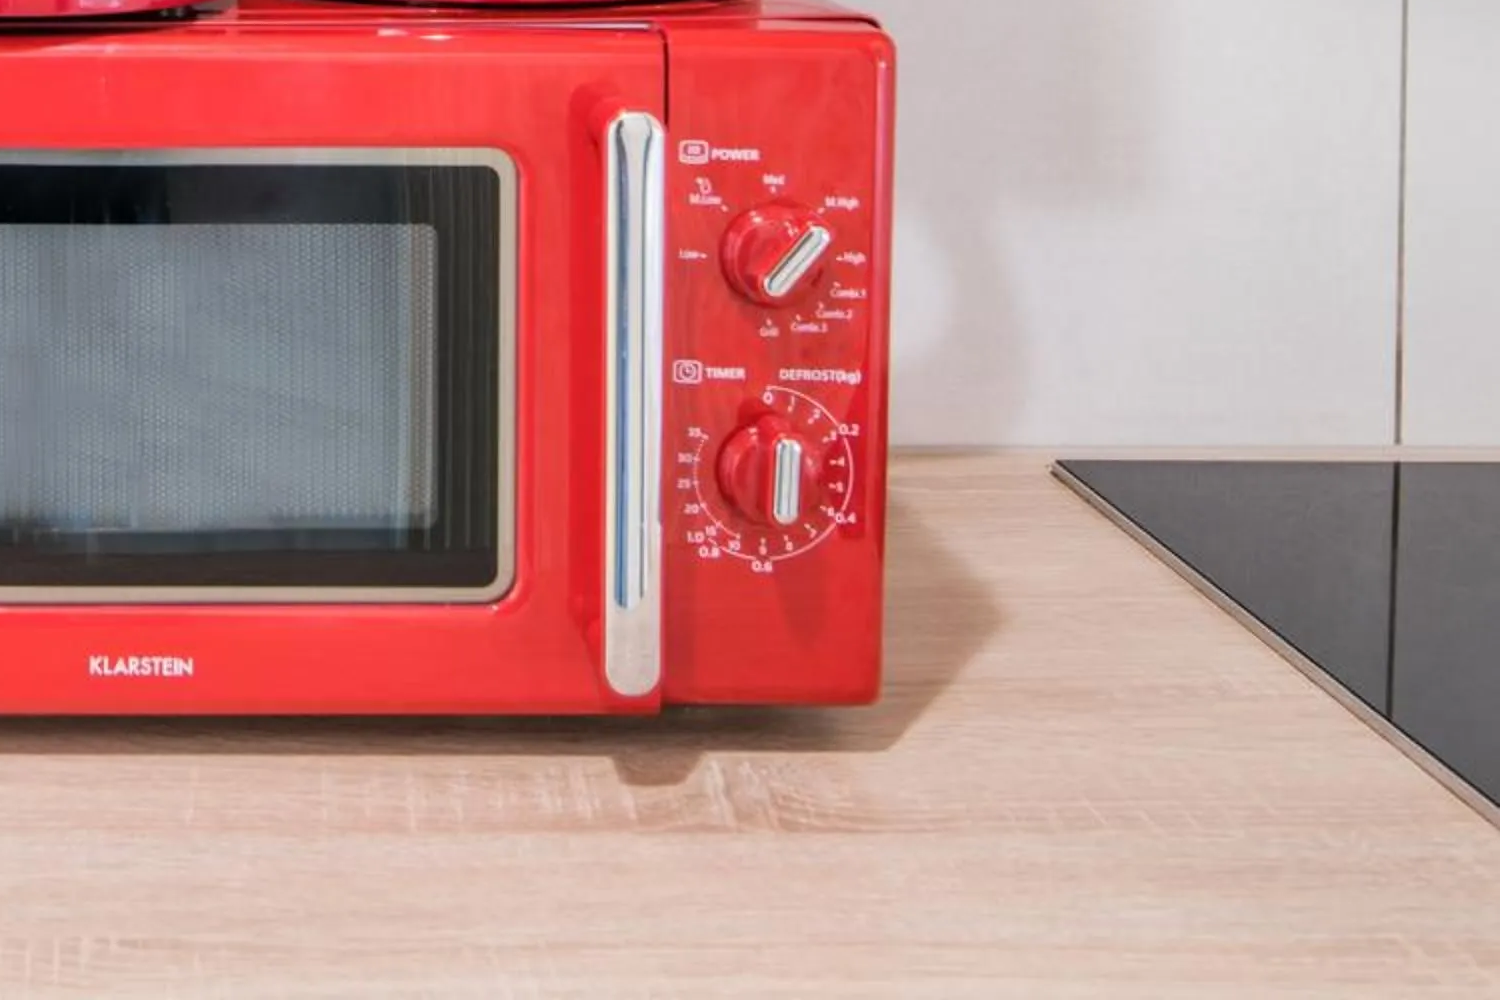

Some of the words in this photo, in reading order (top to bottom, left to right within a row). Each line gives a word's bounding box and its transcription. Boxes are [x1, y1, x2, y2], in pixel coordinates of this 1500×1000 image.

[711, 149, 760, 161] POWER
[705, 367, 746, 379] TIMER
[763, 392, 773, 404] 0
[838, 424, 860, 436] 0.2
[88, 655, 194, 677] KLARSTEIN
